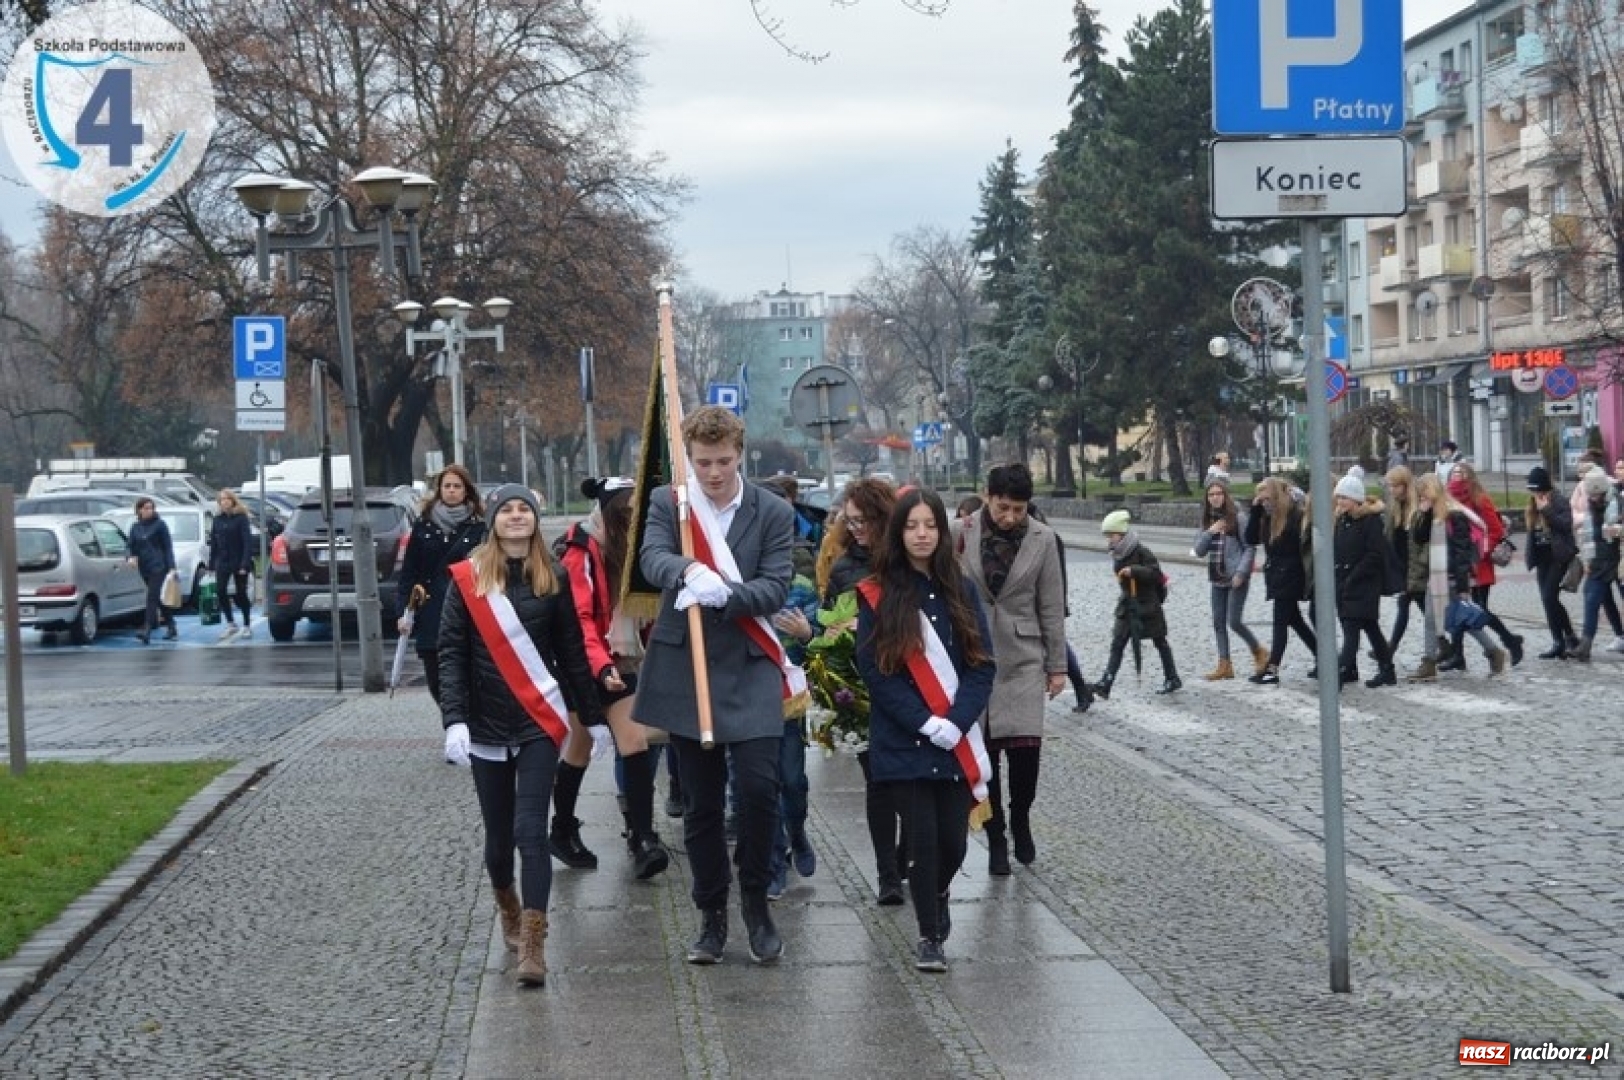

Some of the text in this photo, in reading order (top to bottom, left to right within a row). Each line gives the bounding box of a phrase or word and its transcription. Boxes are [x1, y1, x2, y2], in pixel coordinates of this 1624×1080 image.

[1260, 0, 1363, 110] P
[1313, 98, 1393, 124] Płatny
[1256, 165, 1361, 191] Koniec
[246, 323, 275, 361] P
